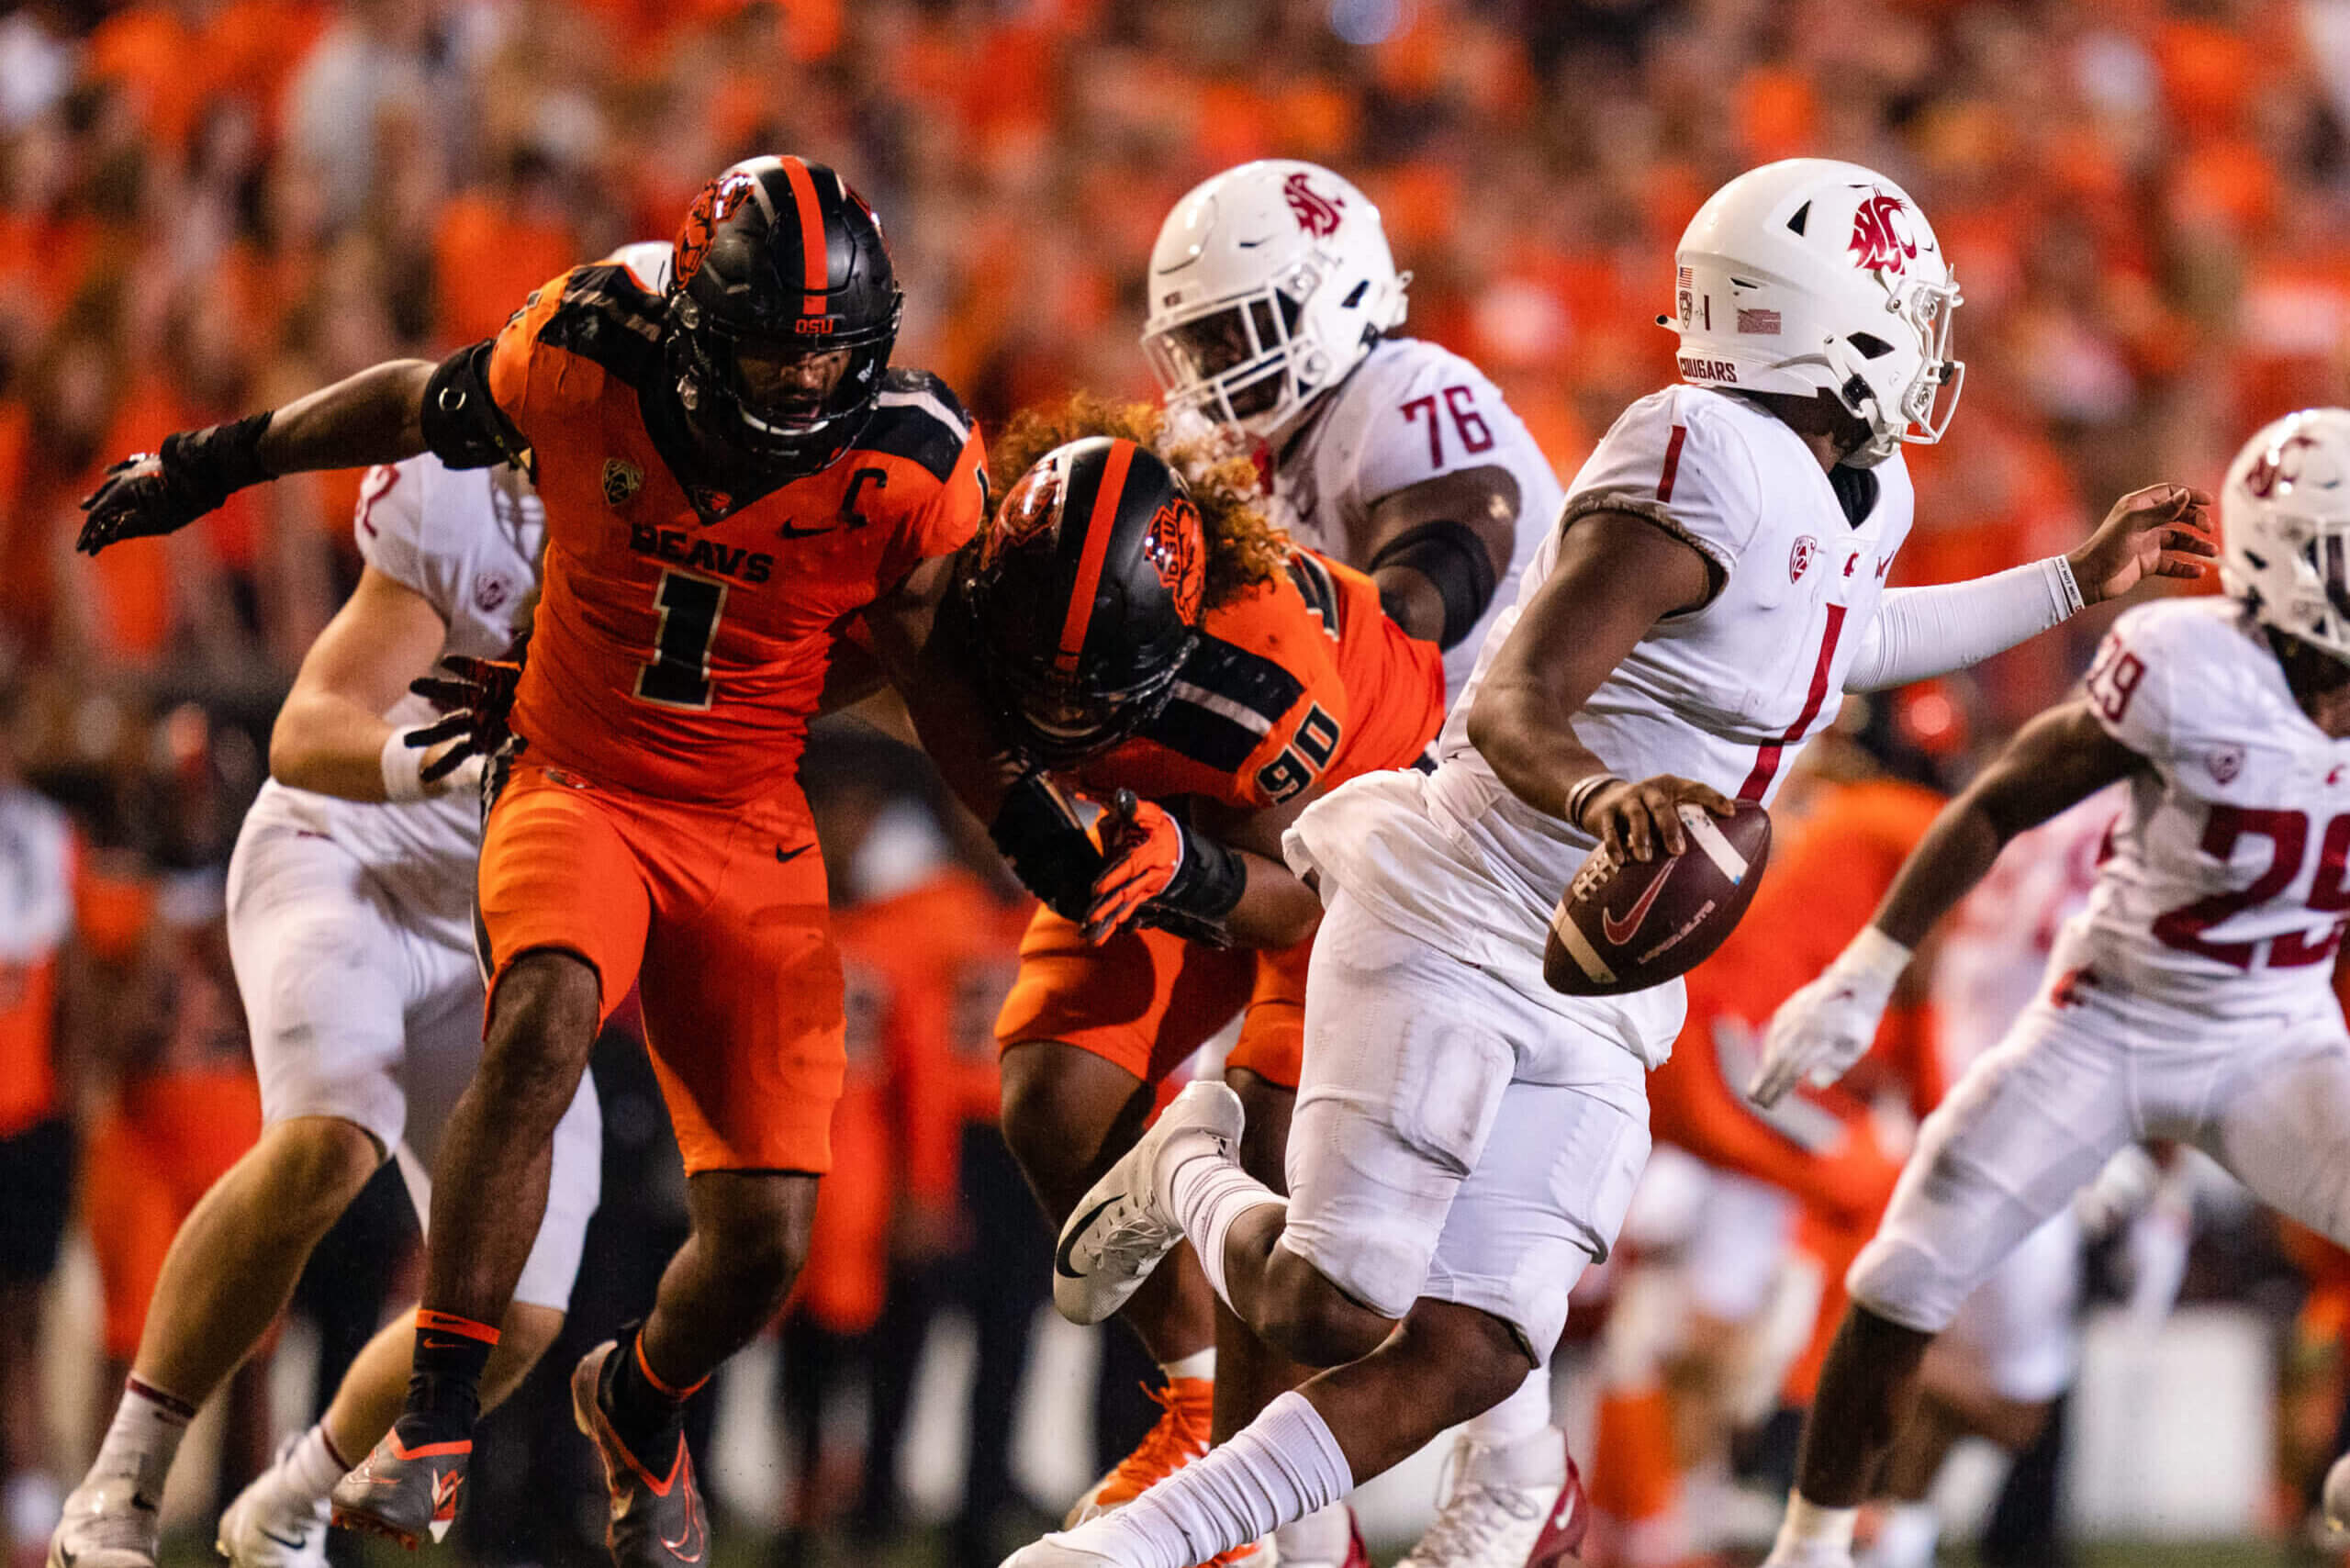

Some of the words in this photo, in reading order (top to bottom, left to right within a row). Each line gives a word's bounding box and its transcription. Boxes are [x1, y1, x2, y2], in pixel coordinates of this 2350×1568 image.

[795, 319, 834, 334] OSU
[1679, 357, 1737, 383] COUGARS
[1398, 386, 1496, 470] 76
[1656, 425, 1687, 503] 1
[355, 463, 401, 539] 2
[840, 467, 888, 530] C
[630, 523, 775, 583] BEAVS
[632, 566, 729, 712] 1
[1737, 601, 1849, 801] 1
[1254, 700, 1342, 806] 90
